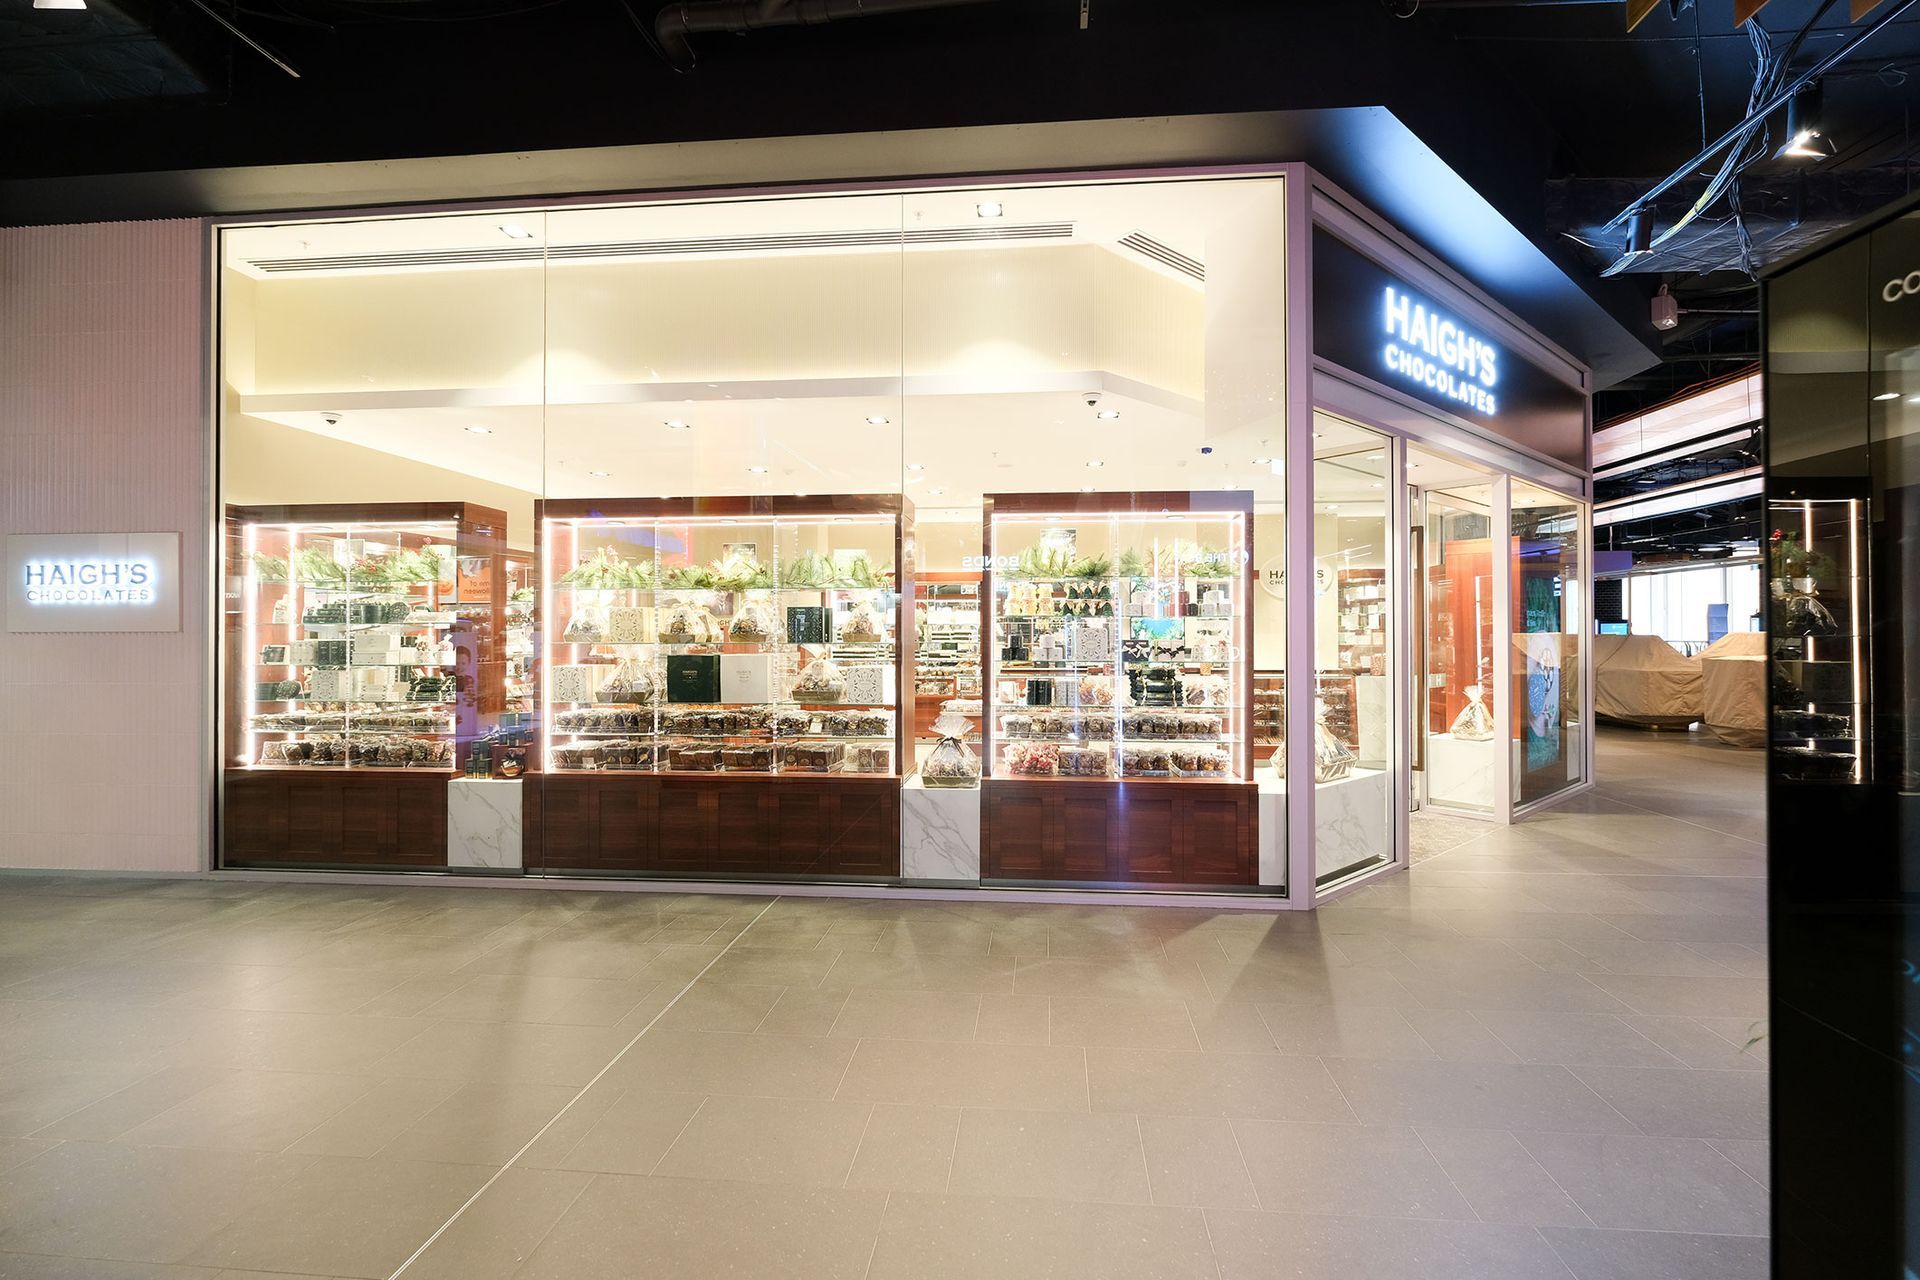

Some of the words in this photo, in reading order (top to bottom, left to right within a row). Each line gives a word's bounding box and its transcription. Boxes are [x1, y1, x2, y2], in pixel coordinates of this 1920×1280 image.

[1385, 286, 1497, 387] HAIGH'S
[1384, 343, 1496, 415] CHOCOLATES
[26, 563, 149, 586] HAIGH'S
[26, 589, 150, 601] CHOCOLATES
